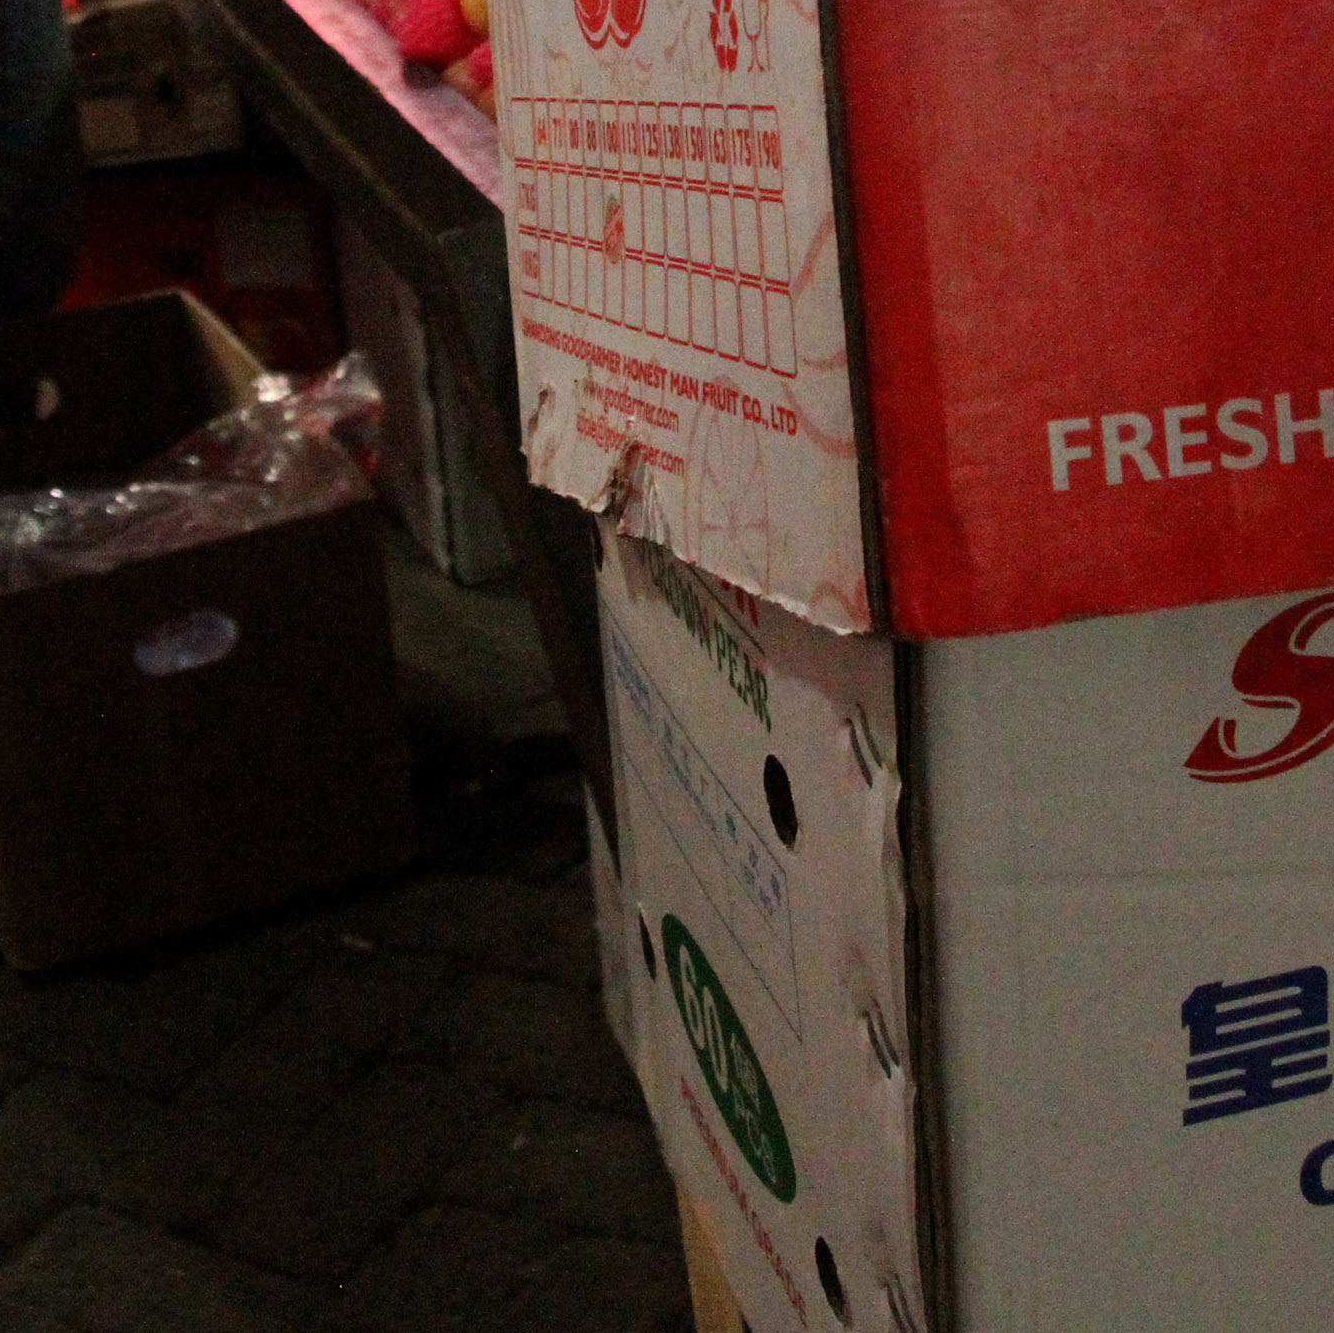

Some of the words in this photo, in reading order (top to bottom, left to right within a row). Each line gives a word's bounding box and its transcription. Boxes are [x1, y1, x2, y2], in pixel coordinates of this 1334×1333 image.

[602, 120, 618, 154] 100
[621, 122, 638, 155] 113
[641, 123, 660, 158] 125
[662, 124, 682, 160] 138
[685, 125, 704, 162] 150
[707, 127, 727, 164] 163
[731, 128, 752, 167] 175
[562, 333, 621, 375] GOODFARMER
[623, 354, 667, 391] HONEST
[670, 370, 699, 403] MAN
[702, 380, 739, 416] FRUIT
[742, 394, 769, 430] CO.,
[771, 404, 797, 436] LTD
[713, 618, 772, 734] PEAR
[679, 942, 728, 1094] 60
